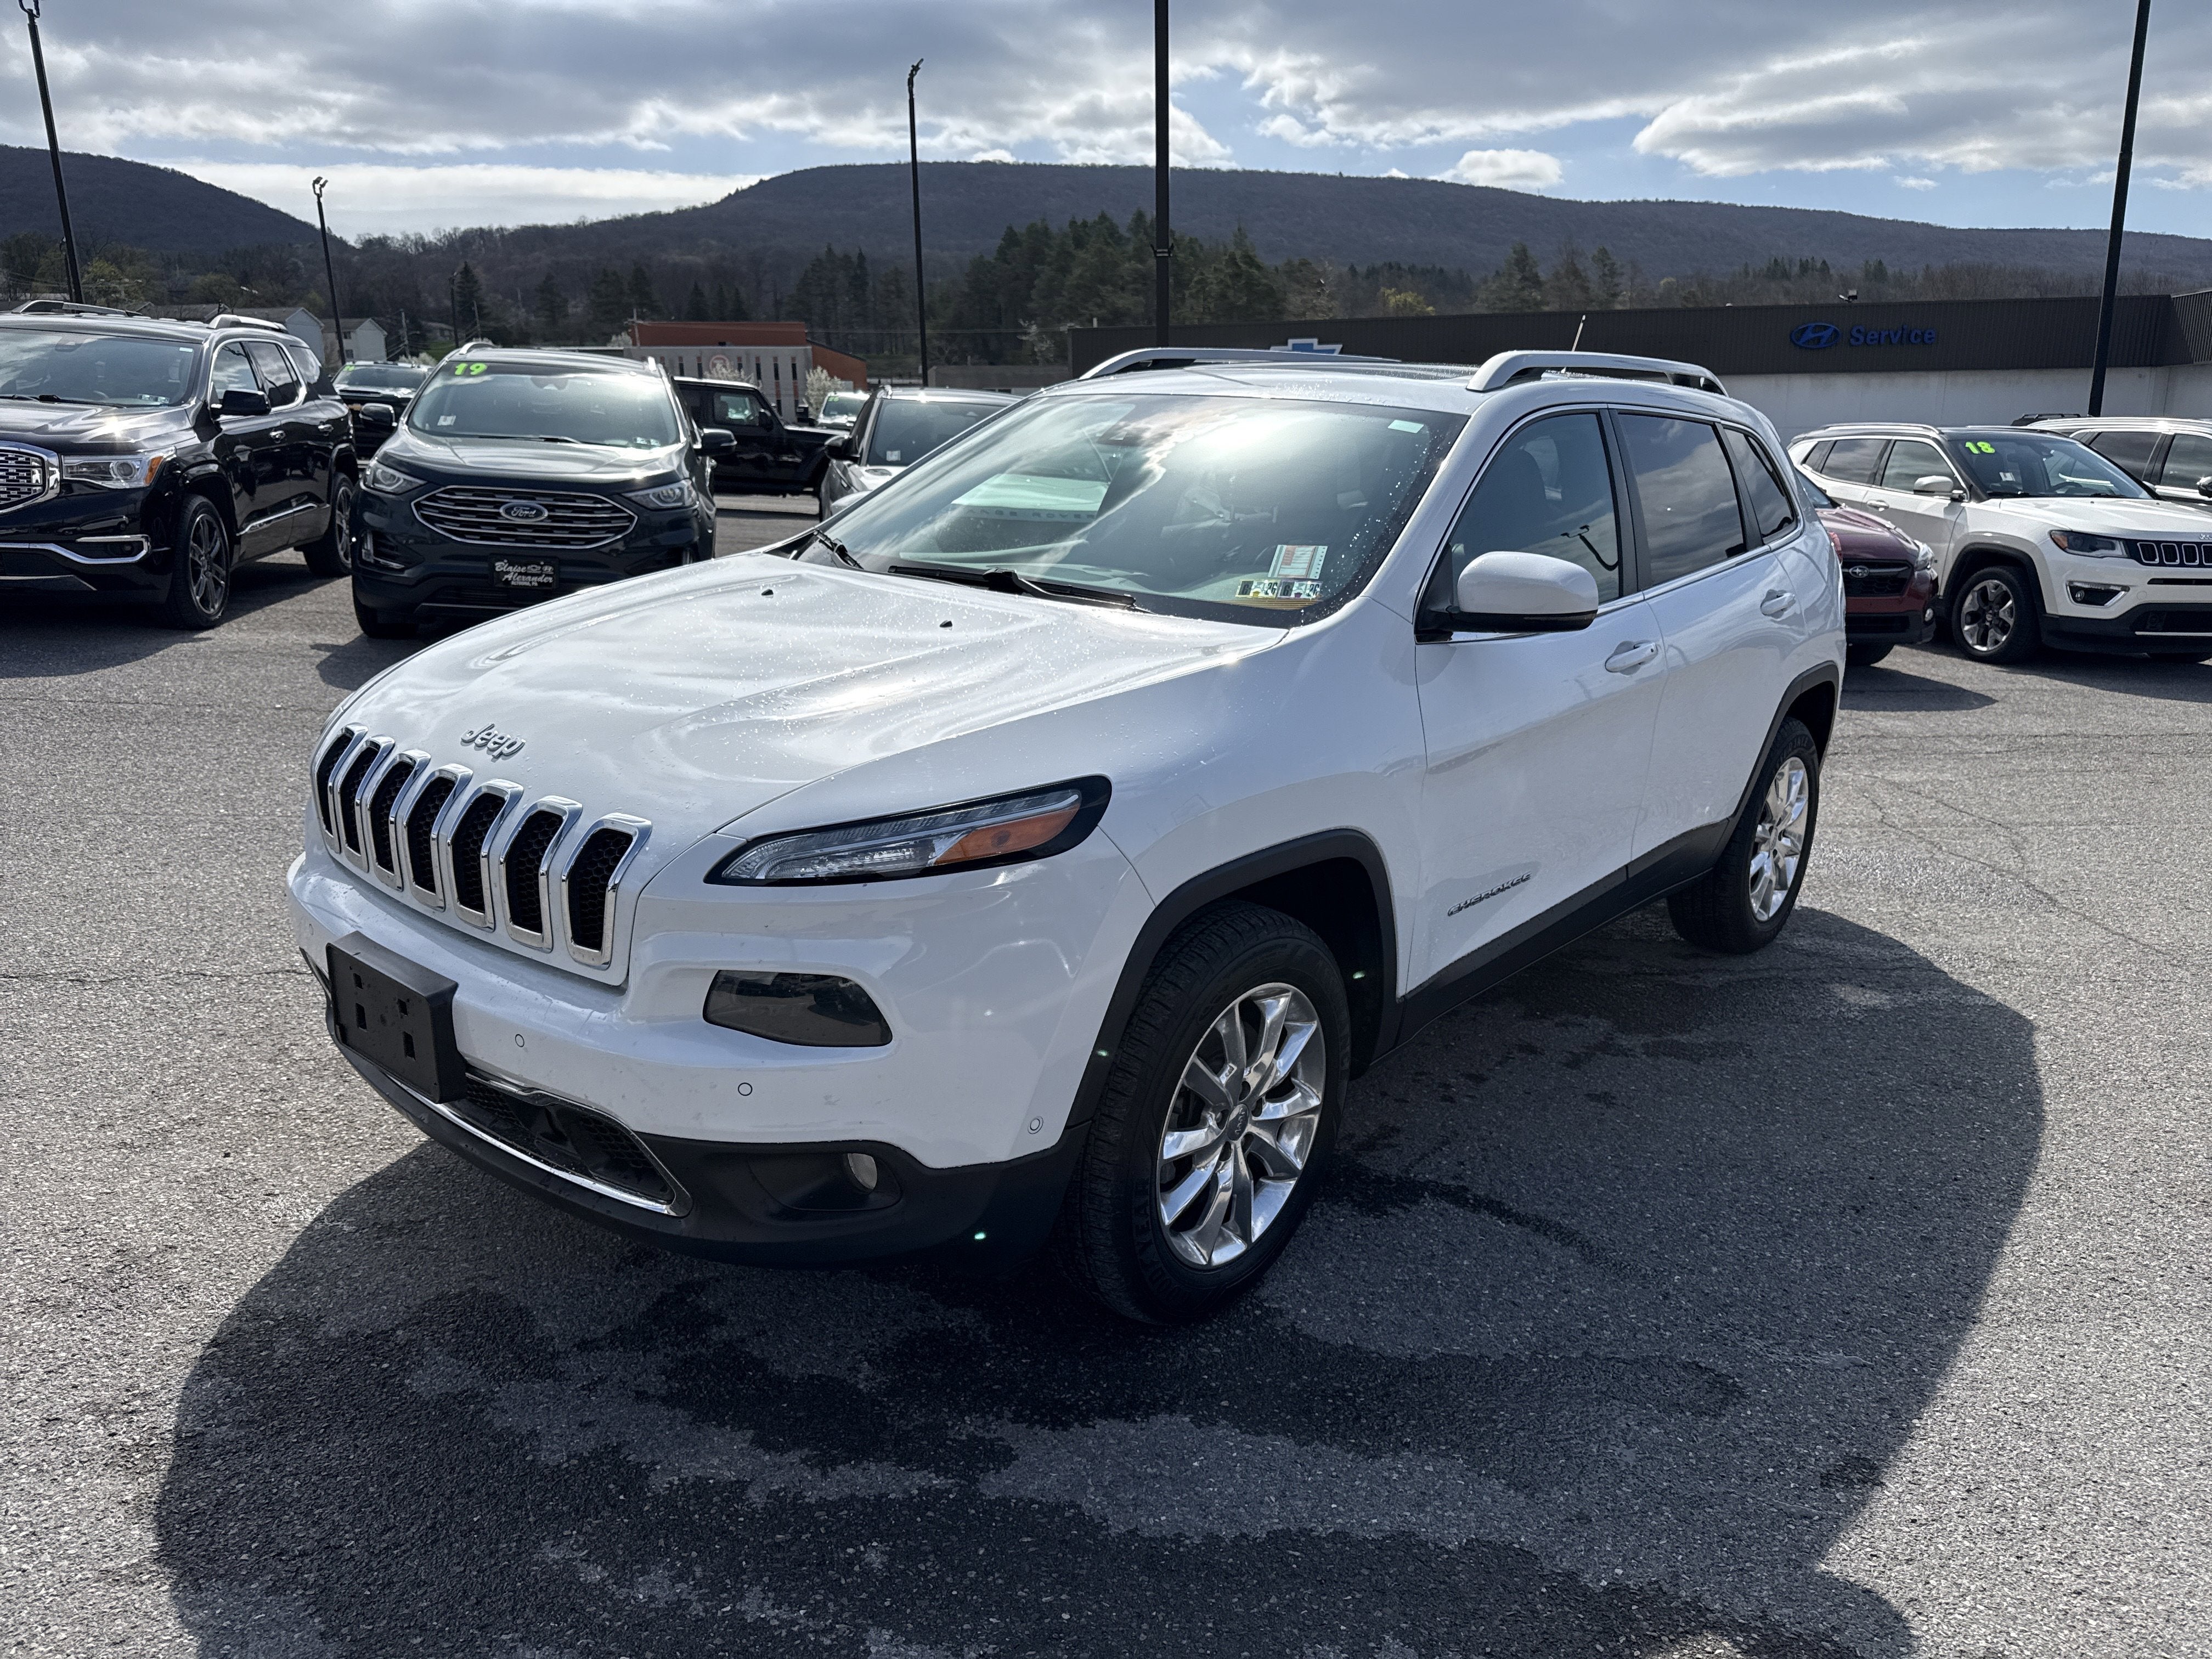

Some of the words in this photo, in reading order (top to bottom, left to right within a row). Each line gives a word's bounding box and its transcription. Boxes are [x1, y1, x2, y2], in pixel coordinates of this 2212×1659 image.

[1849, 324, 1937, 346] Service
[454, 363, 487, 376] 19
[1965, 441, 1996, 455] 18
[511, 506, 537, 518] Ford
[495, 561, 527, 573] Blaise
[501, 572, 554, 583] Alexander
[461, 723, 526, 759] Jeep
[1447, 871, 1532, 917] CHEROKEE
